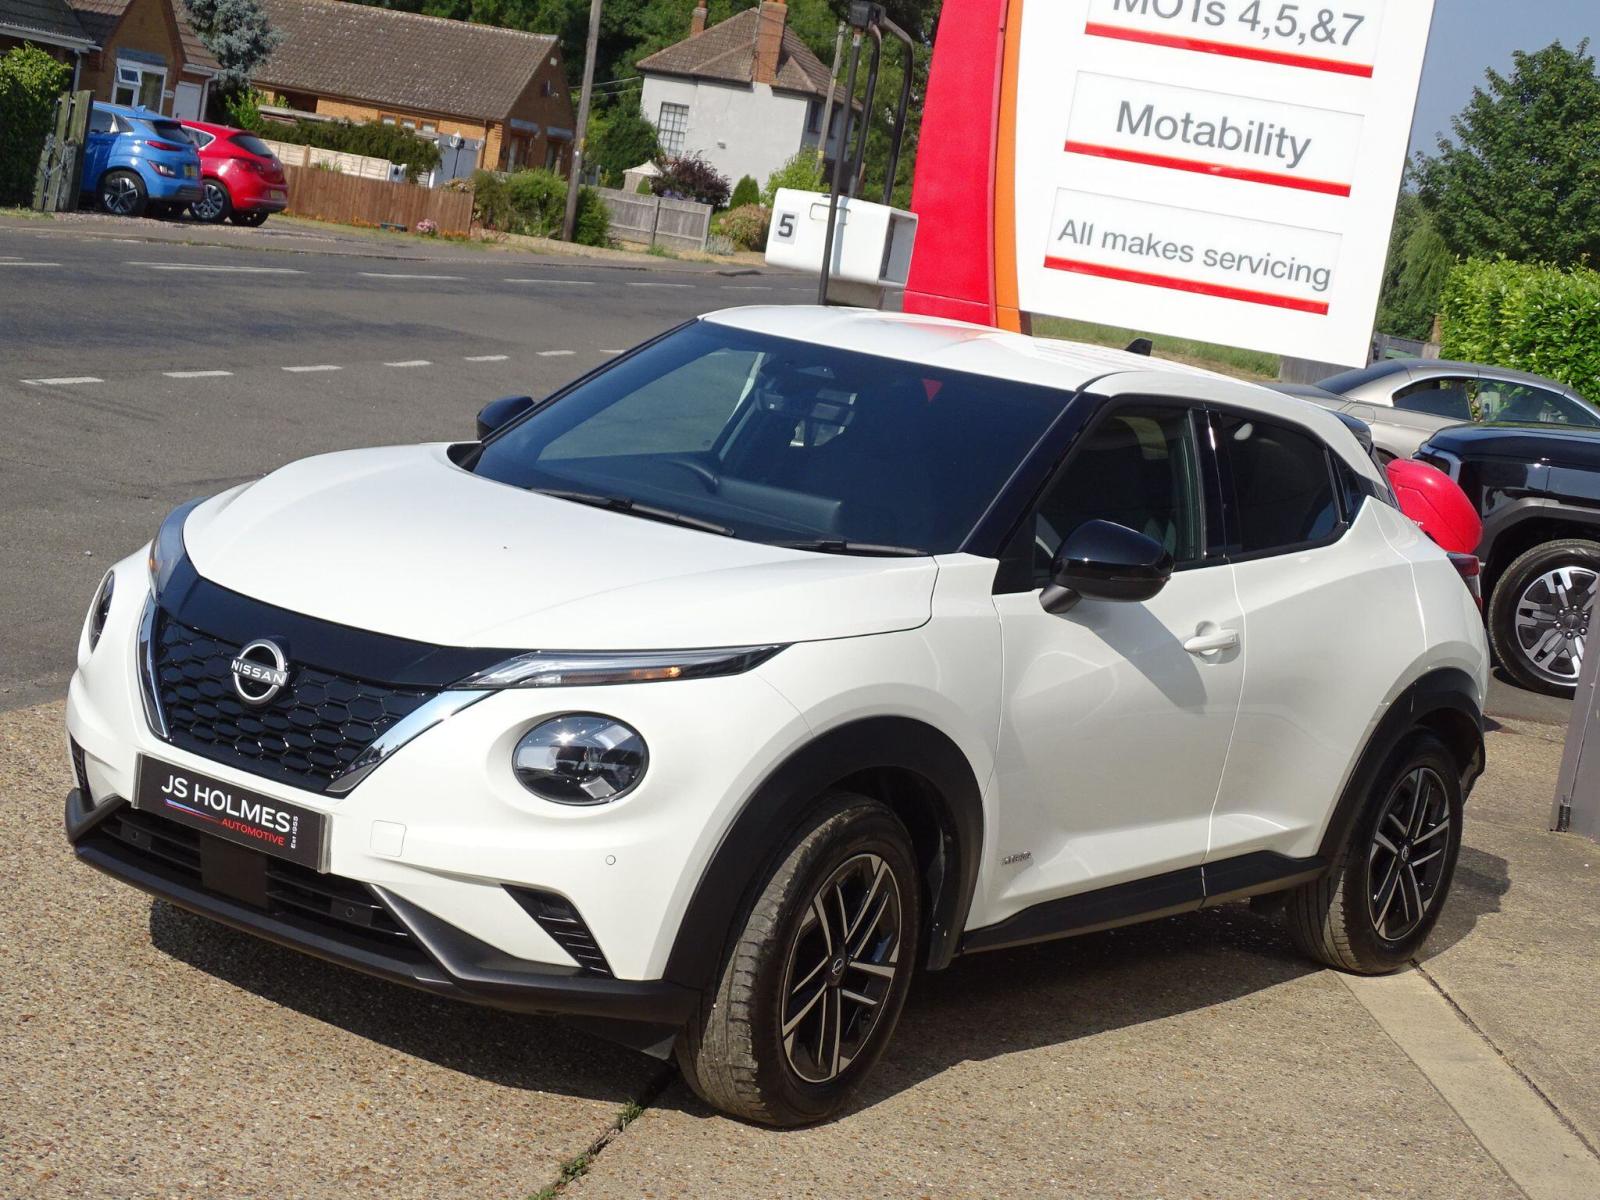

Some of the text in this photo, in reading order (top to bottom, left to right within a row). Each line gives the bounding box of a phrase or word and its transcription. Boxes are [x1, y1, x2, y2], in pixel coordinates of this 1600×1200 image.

[1237, 0, 1366, 47] 4,5,&7
[1115, 100, 1312, 169] Motability
[777, 213, 795, 238] 5
[1057, 219, 1332, 293] All makes servicing
[231, 659, 286, 686] NISSAN
[161, 774, 291, 833] JS HOLMES
[221, 817, 286, 847] AUTOMOTIVE
